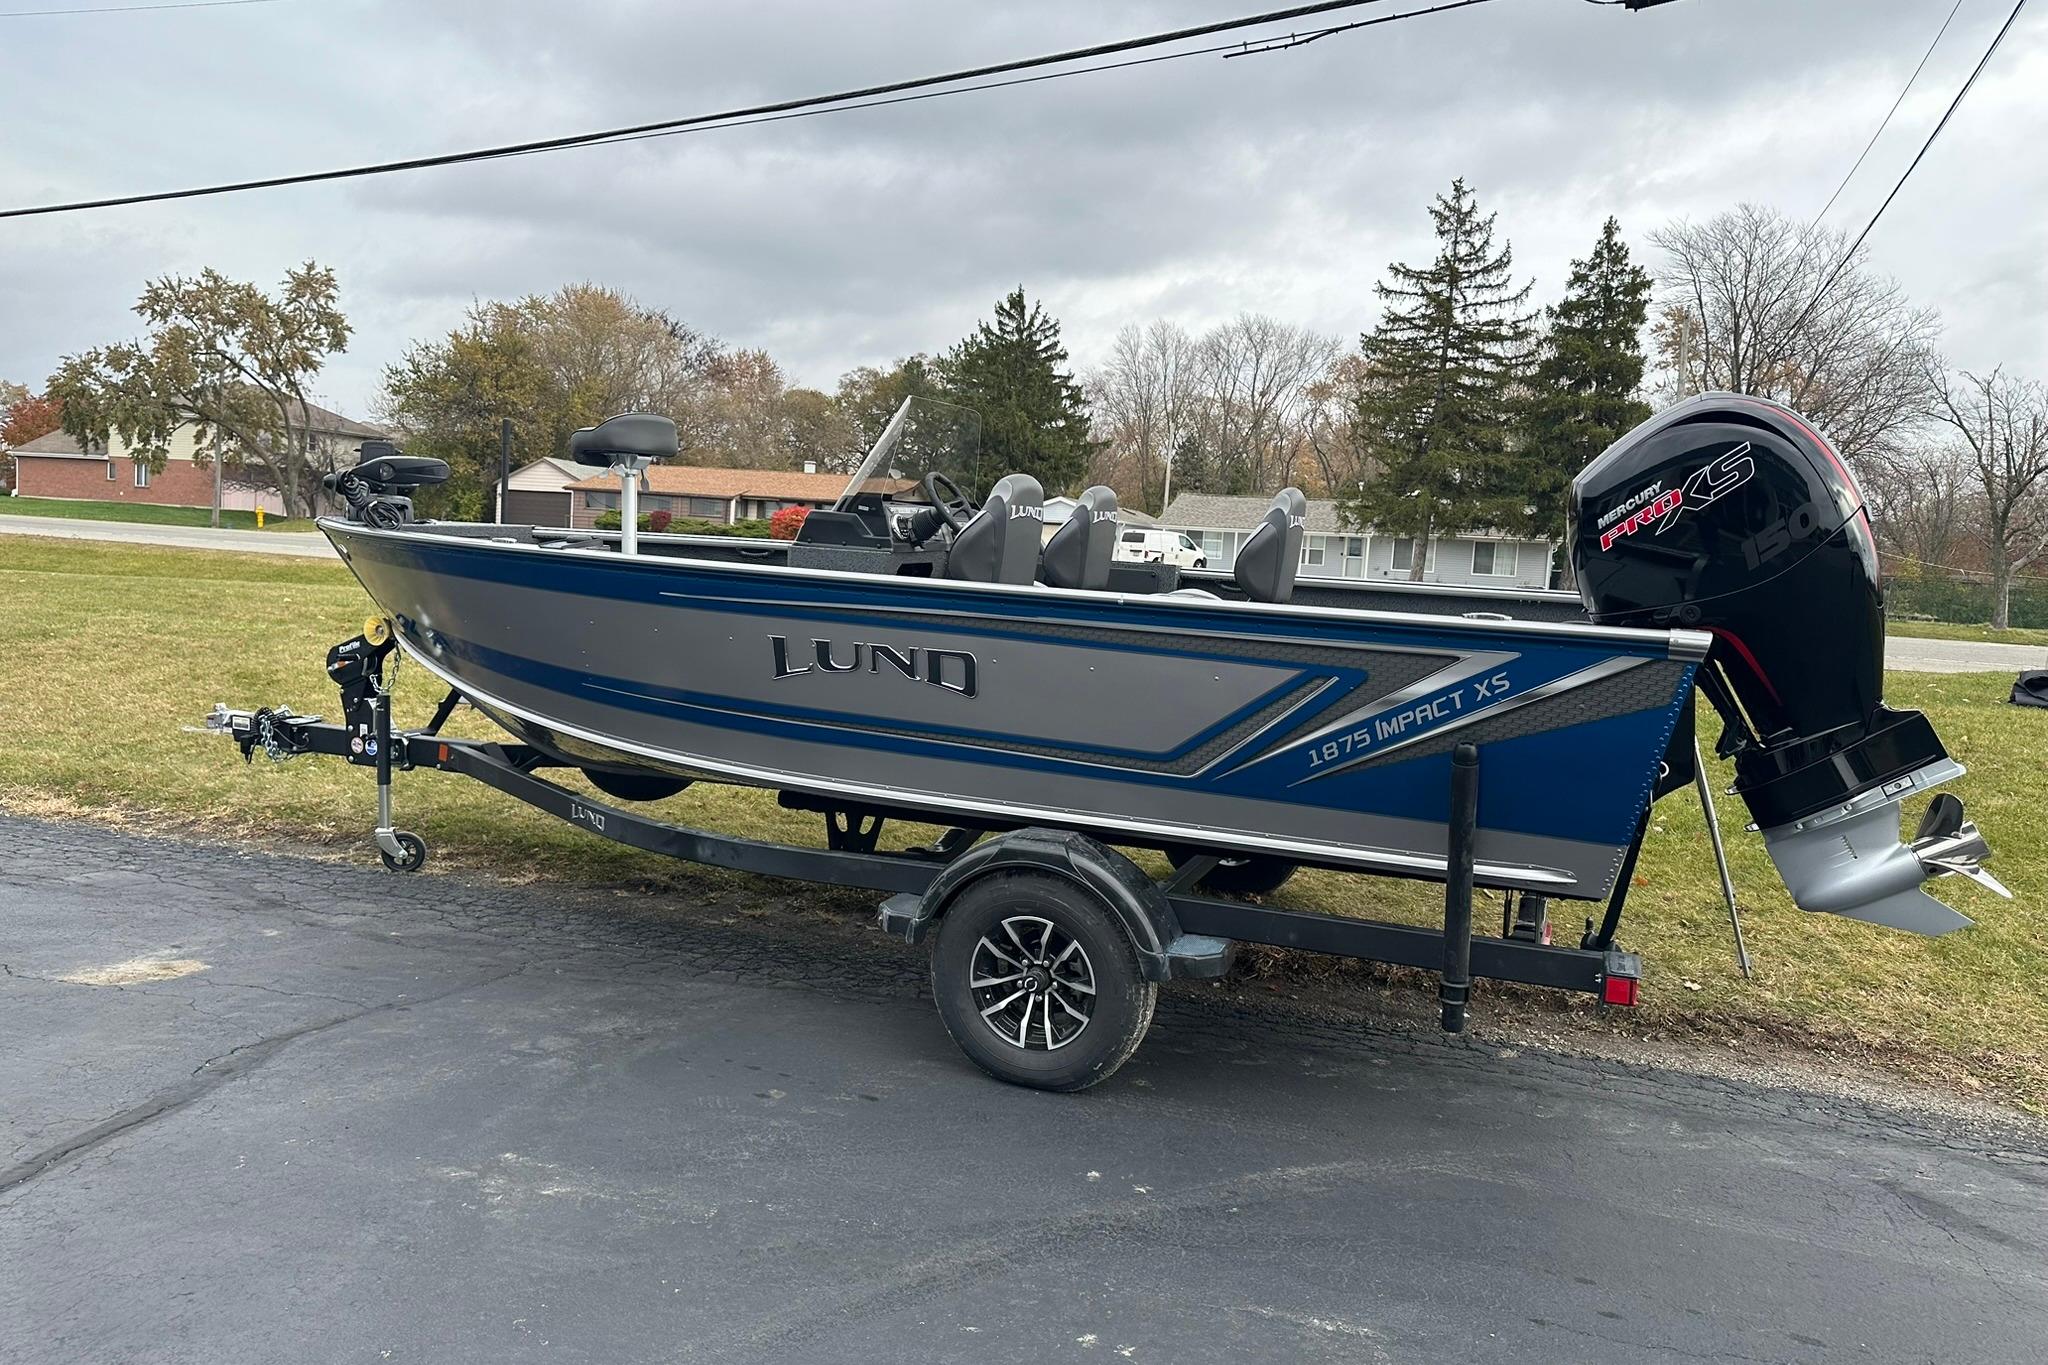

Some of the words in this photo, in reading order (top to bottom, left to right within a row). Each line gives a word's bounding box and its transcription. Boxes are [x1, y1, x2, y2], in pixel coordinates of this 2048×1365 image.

[1597, 480, 1662, 530] MERCURY
[1742, 502, 1819, 570] 150
[767, 635, 978, 698] LUND
[1309, 728, 1371, 768] 1875
[1375, 689, 1464, 741] IMPACT
[1473, 671, 1510, 702] XS
[571, 803, 605, 831] LUND
